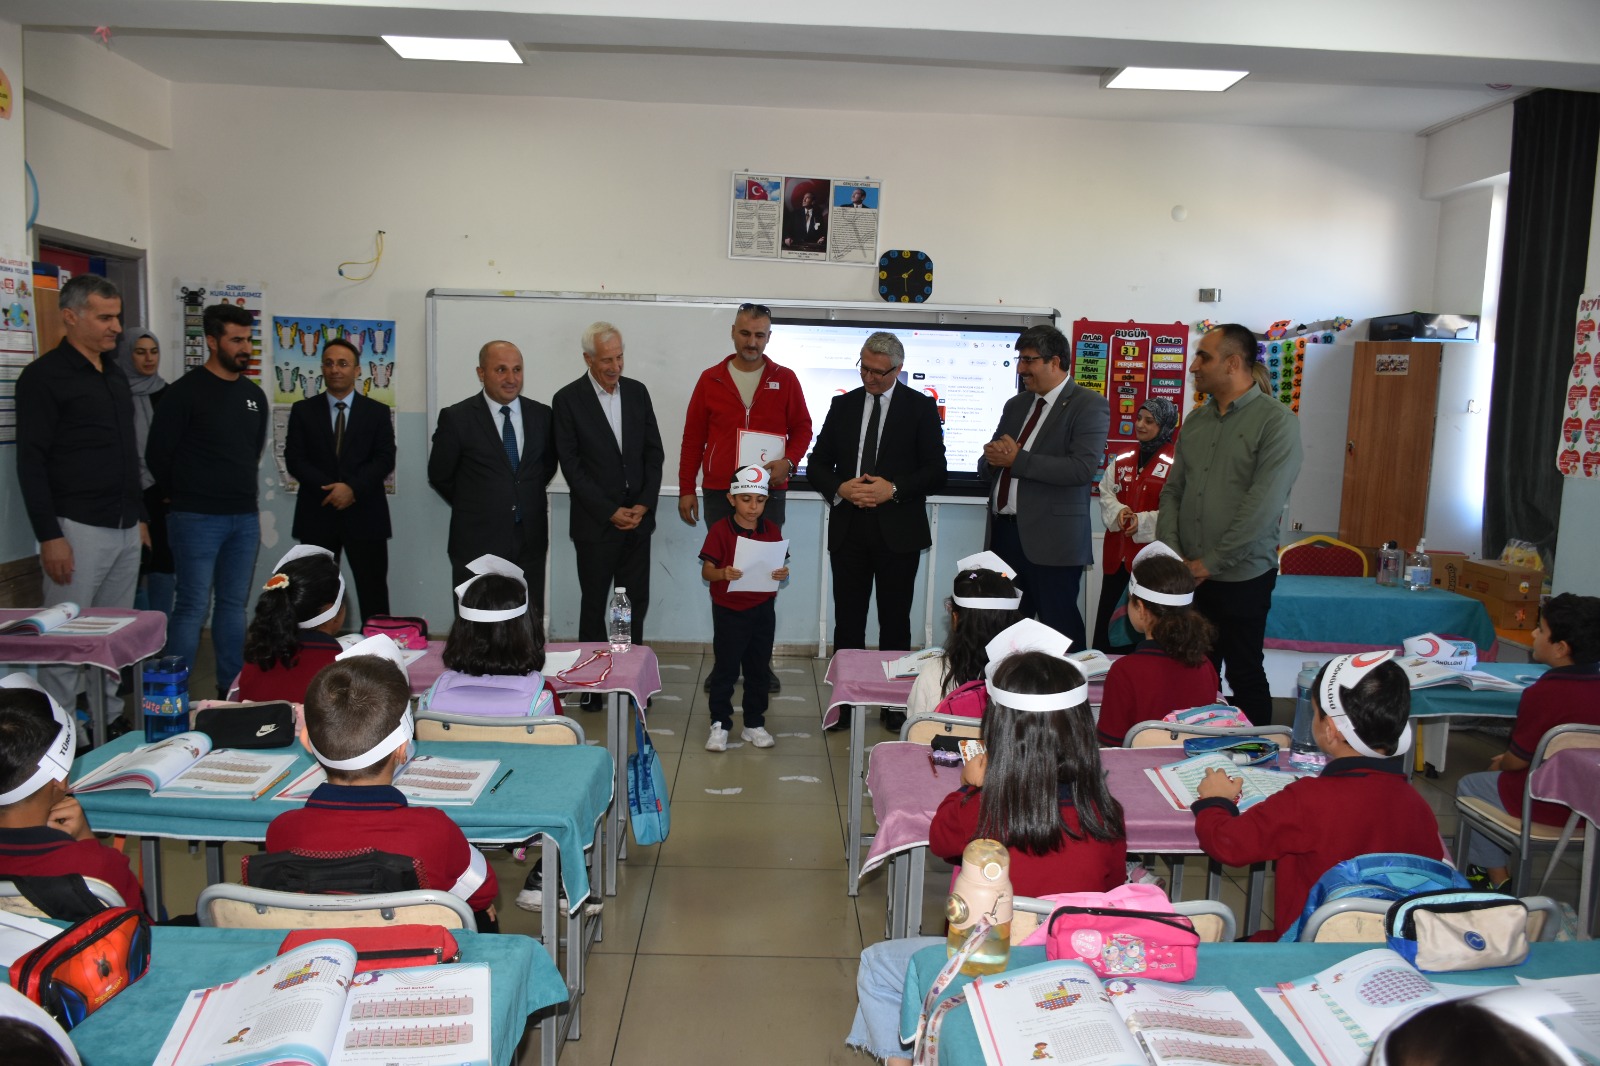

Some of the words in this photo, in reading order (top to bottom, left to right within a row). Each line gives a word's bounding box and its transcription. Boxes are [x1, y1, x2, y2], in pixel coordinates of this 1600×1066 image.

[1115, 329, 1147, 338] BUGÜN
[1322, 335, 1334, 344] 10
[1286, 344, 1292, 352] 7
[1300, 341, 1305, 349] 8
[1271, 346, 1278, 354] 6
[1269, 359, 1279, 367] 12
[1284, 357, 1293, 365] 14
[1283, 370, 1292, 378] 21
[1281, 382, 1293, 390] 28
[1280, 395, 1291, 403] 35
